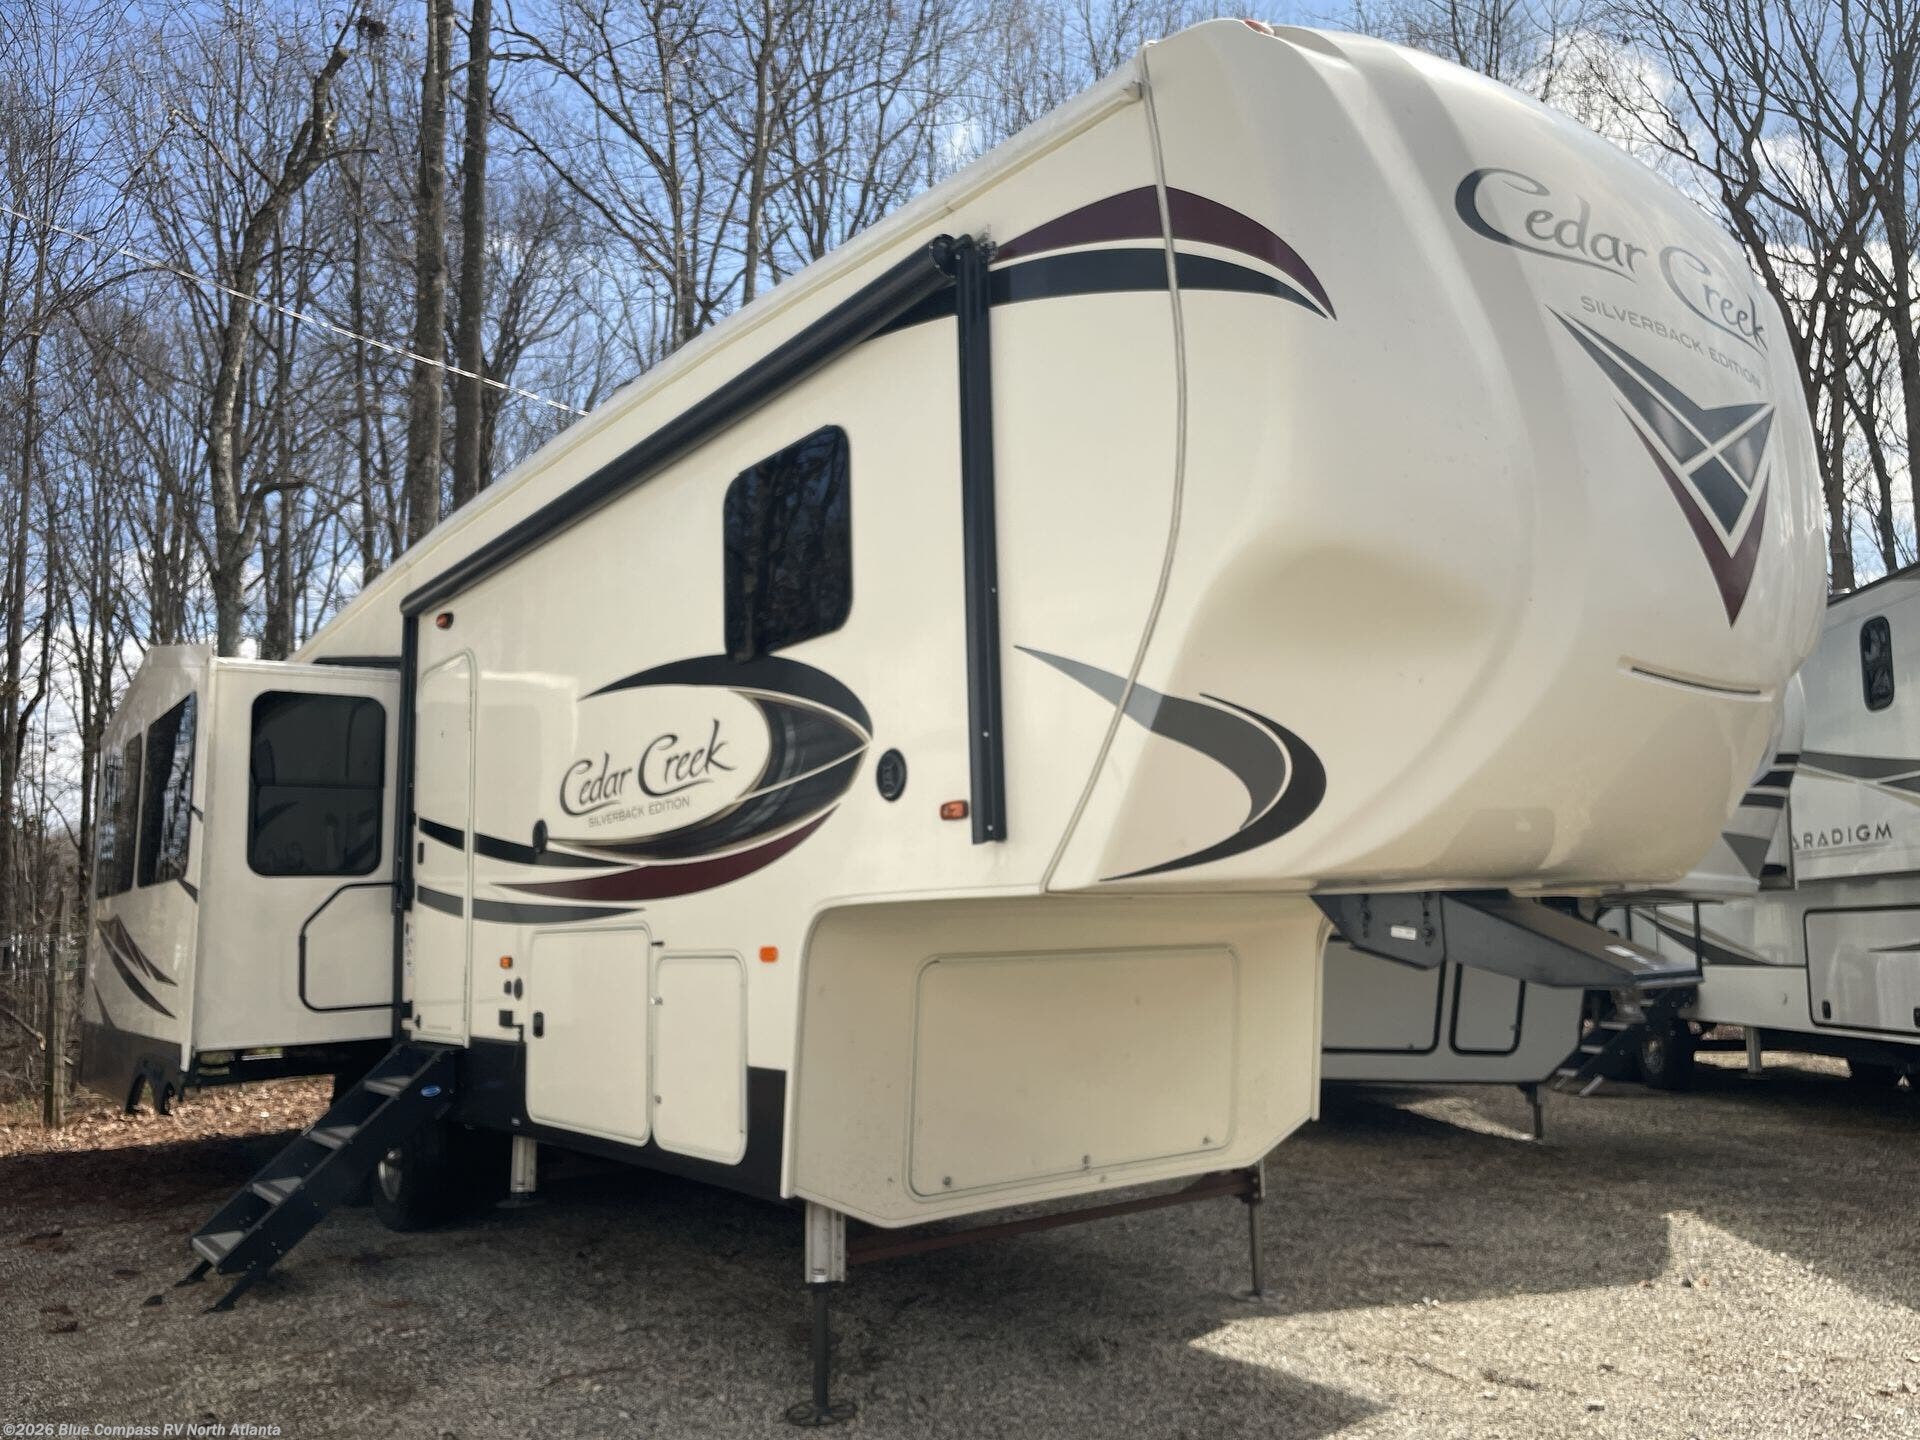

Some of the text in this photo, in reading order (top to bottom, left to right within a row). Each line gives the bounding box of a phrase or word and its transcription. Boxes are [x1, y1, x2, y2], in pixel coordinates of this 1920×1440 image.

[1454, 167, 1769, 360] Cedar Creek
[1579, 295, 1762, 390] SILVERBACK EDITION
[559, 718, 737, 817] Cedar Creek
[588, 796, 691, 828] SILVERBACK EDITION
[1791, 822, 1893, 850] ARADIGM
